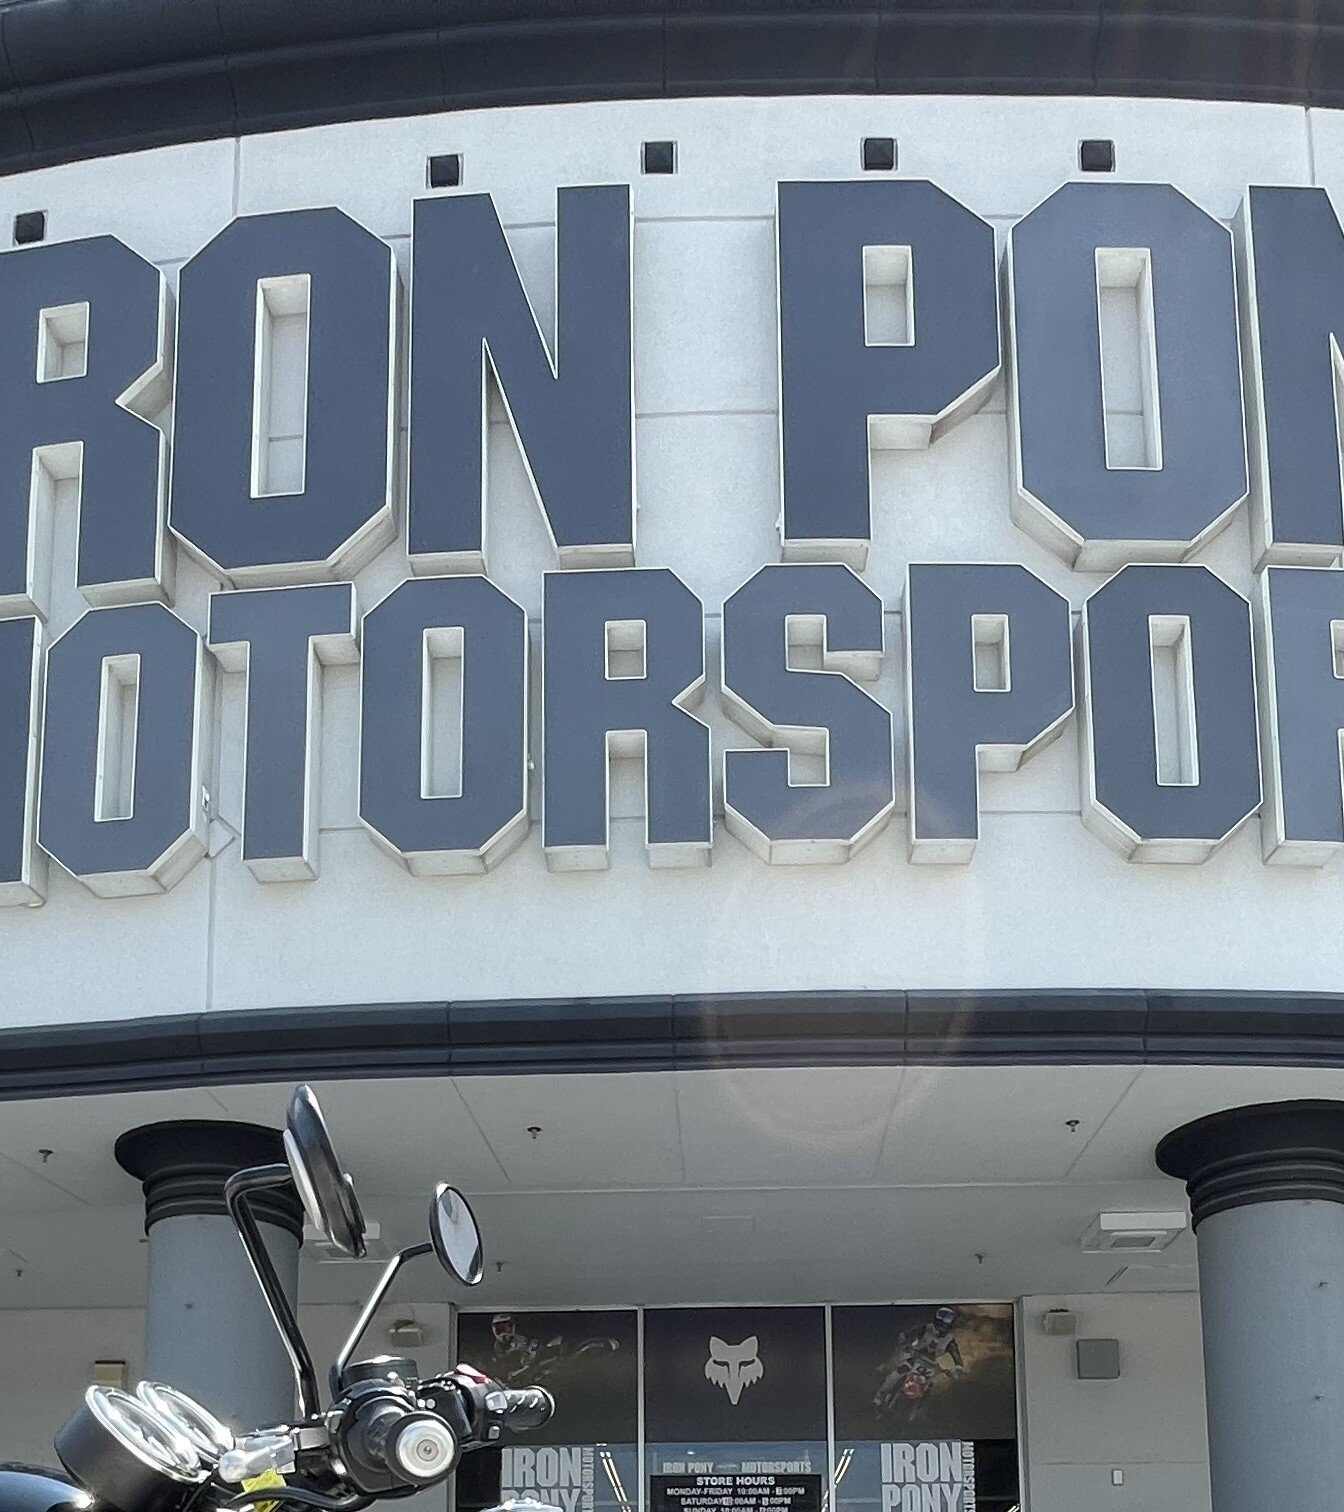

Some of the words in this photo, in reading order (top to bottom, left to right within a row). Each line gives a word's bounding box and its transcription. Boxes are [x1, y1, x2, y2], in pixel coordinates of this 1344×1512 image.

[501, 1447, 581, 1488] IRON
[662, 1461, 686, 1473] IRON
[688, 1461, 714, 1473] PONY
[741, 1461, 812, 1473] MOTORSPORTS
[880, 1442, 962, 1483] IRON
[696, 1476, 733, 1486] STORE
[736, 1476, 775, 1485] HOURS
[666, 1487, 733, 1496] MONDAY-FRIDAY
[680, 1497, 723, 1506] SATURDAY
